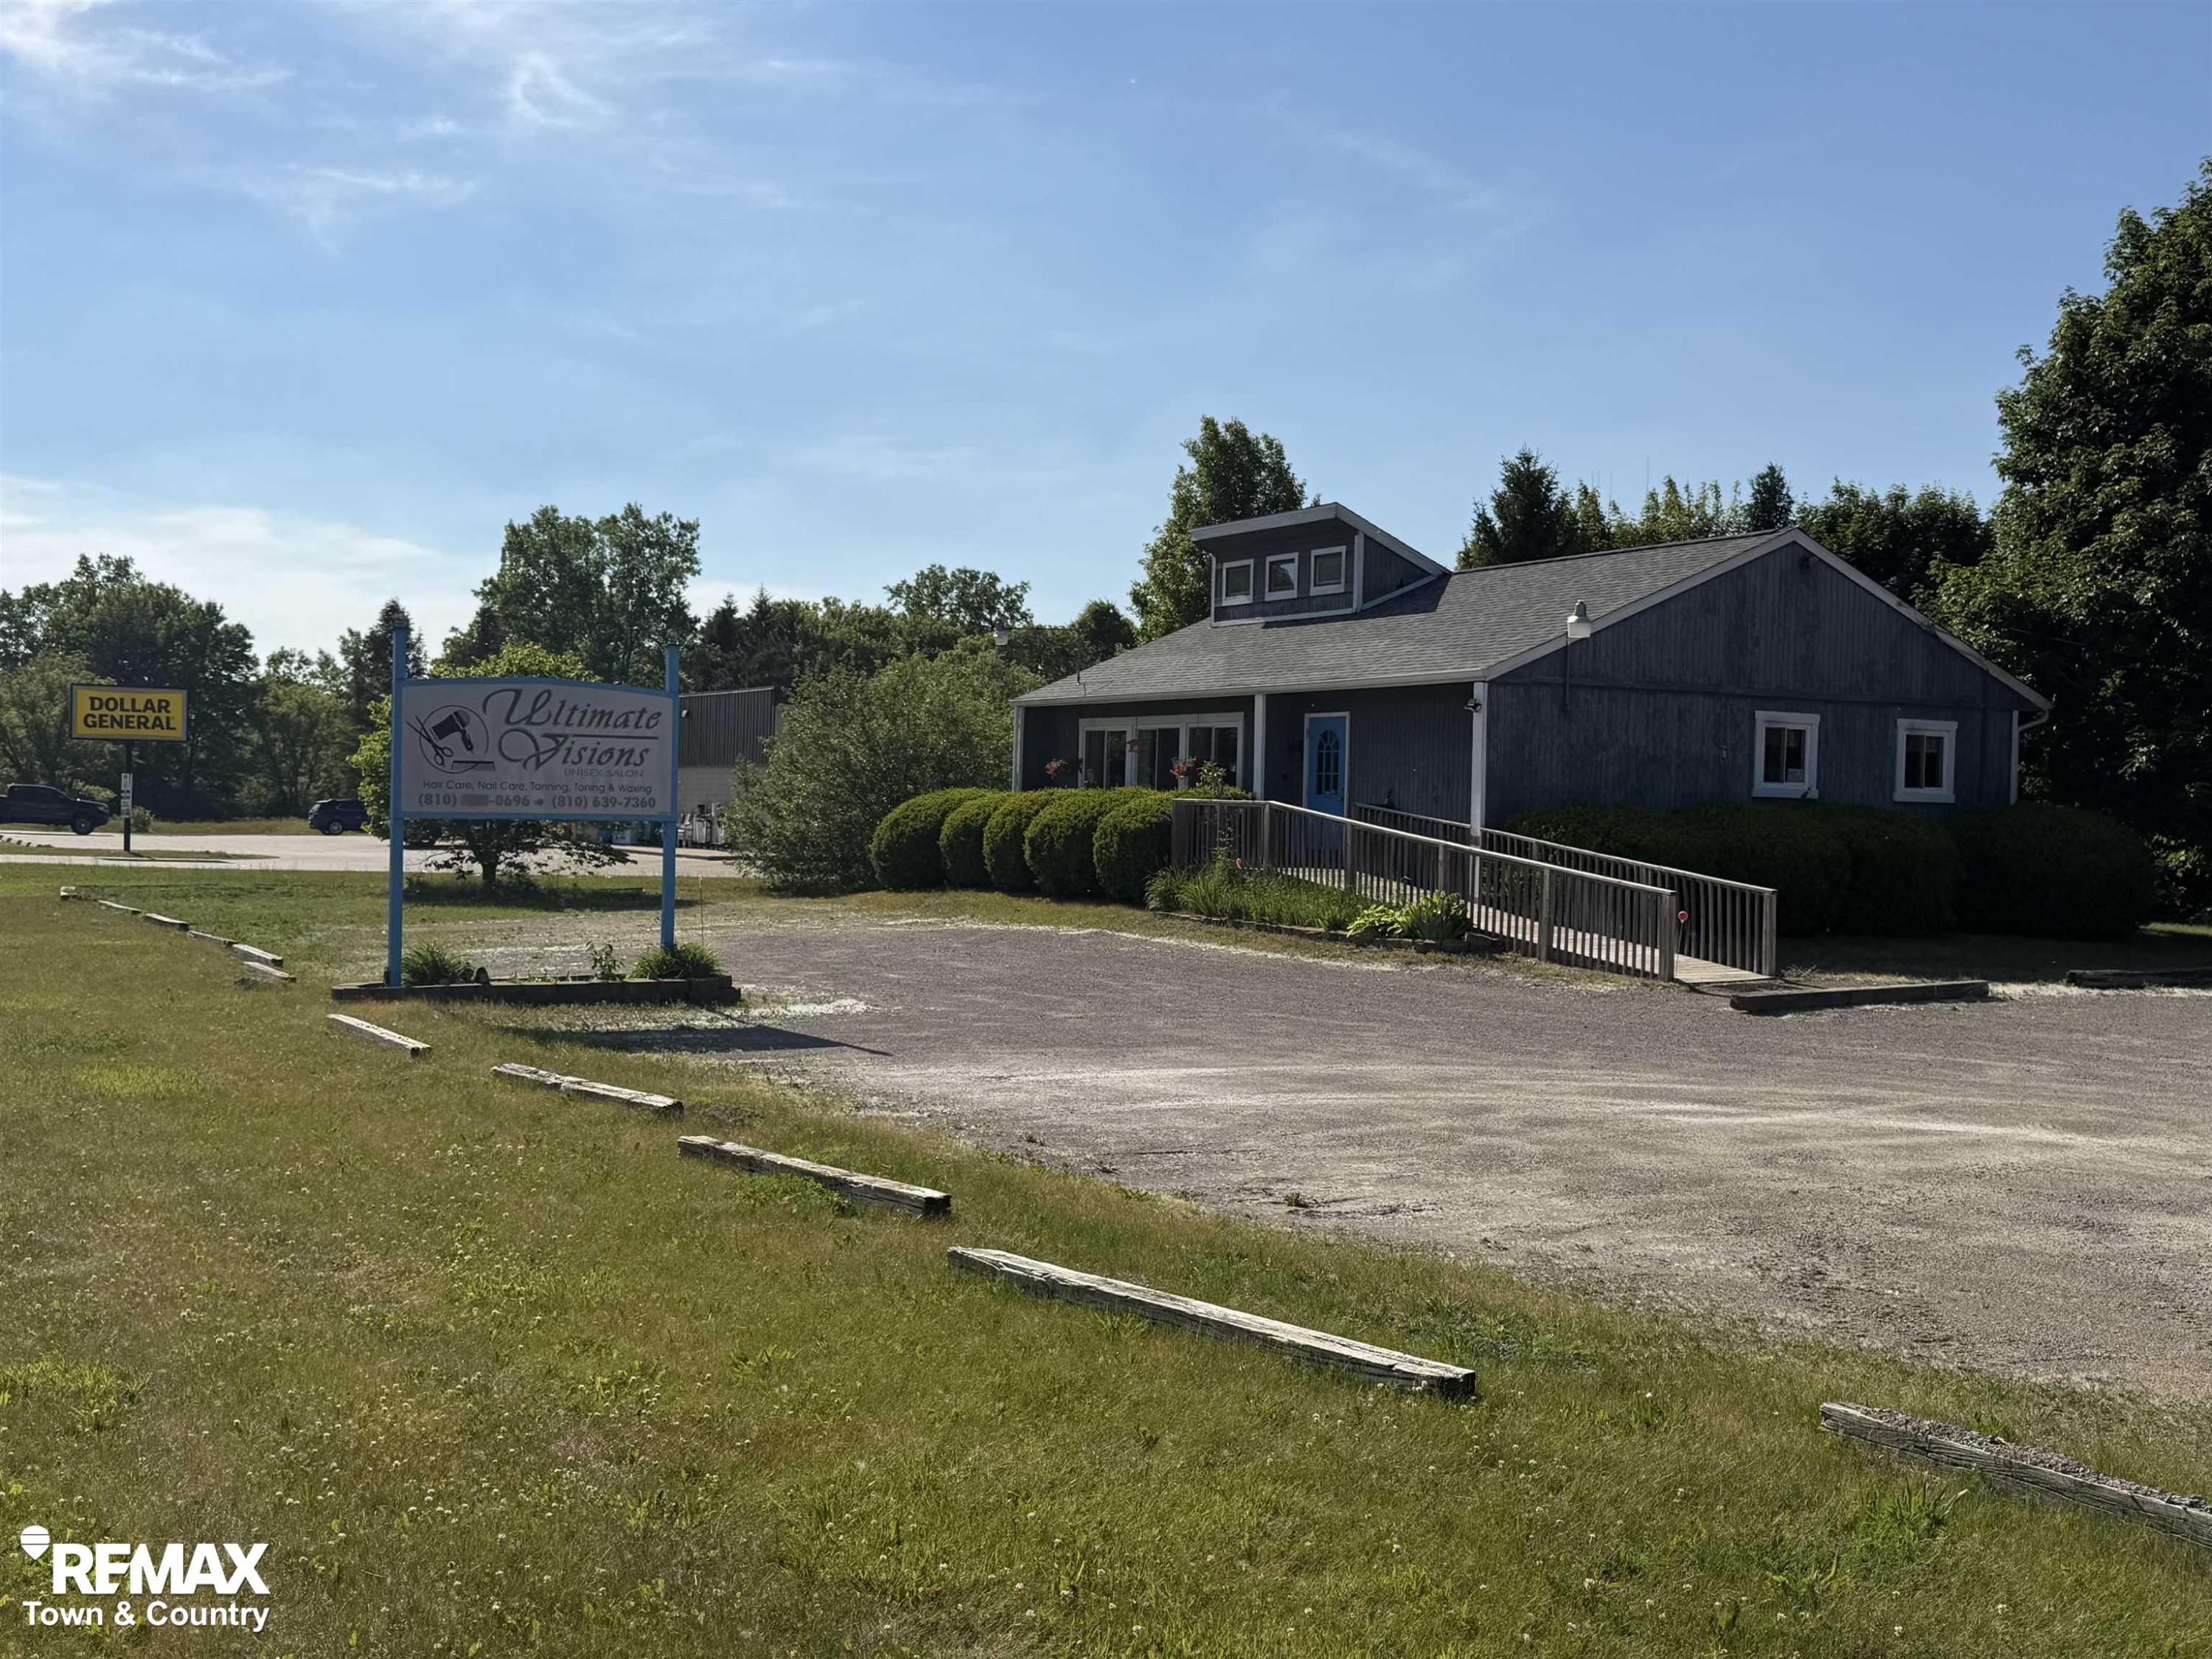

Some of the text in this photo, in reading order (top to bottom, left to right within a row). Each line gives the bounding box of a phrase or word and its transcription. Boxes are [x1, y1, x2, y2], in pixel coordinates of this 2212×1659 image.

[89, 697, 171, 713] DOLLAR
[482, 686, 661, 729] Ultimate
[83, 714, 176, 730] GENERAL
[498, 727, 650, 771] Visions
[565, 768, 643, 777] UNISEX SALON
[423, 780, 442, 789] Hair
[478, 782, 497, 790] Nail
[574, 783, 605, 794] Toning
[608, 784, 615, 792] &
[619, 785, 652, 795] Waxing
[419, 793, 457, 807] (810)
[552, 795, 588, 809] (810)
[592, 796, 655, 808] 639-7360
